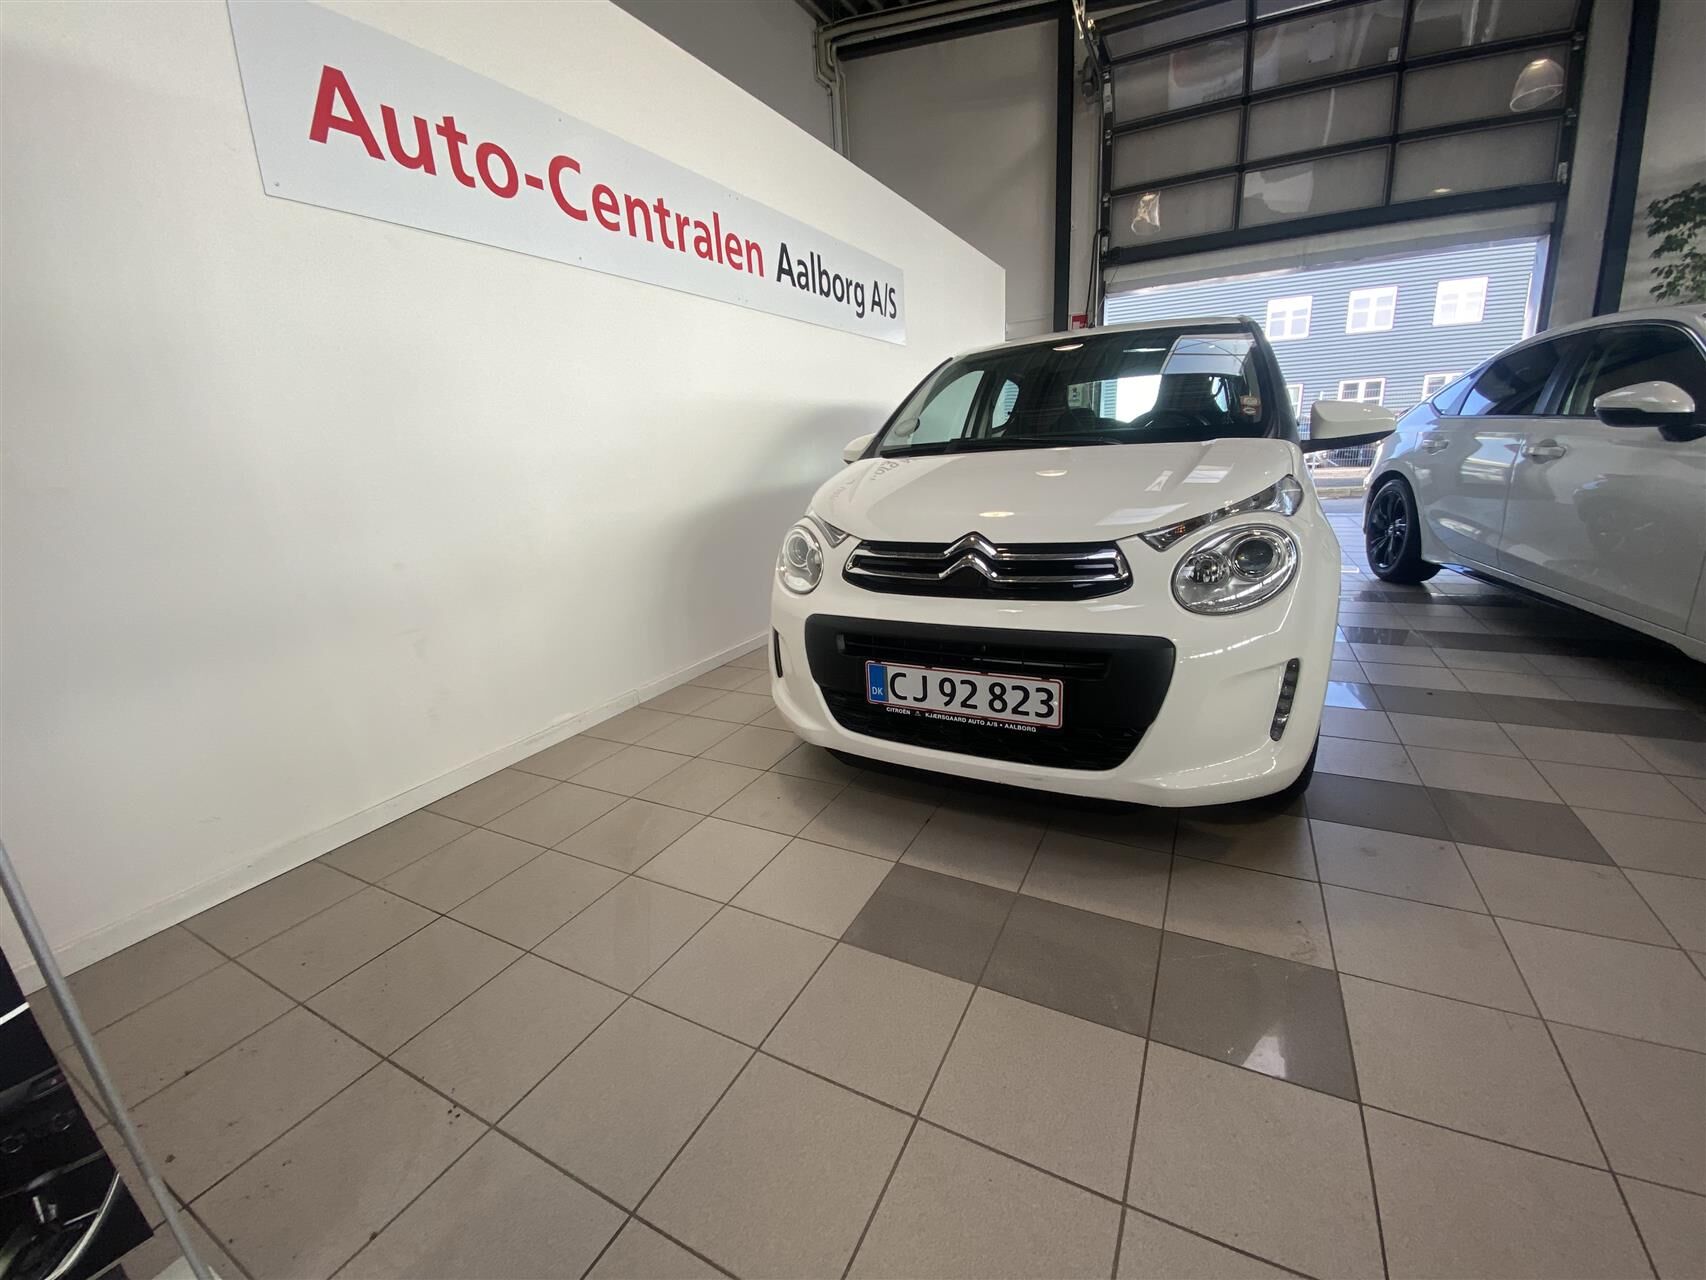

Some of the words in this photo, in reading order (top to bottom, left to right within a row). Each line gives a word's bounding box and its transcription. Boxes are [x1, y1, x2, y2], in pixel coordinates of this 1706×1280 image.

[309, 64, 765, 278] Auto-Centralen
[776, 242, 866, 319] Aalborg
[870, 280, 897, 319] A/S
[872, 686, 883, 696] DK
[889, 672, 928, 702] CJ
[938, 677, 978, 709] 92
[988, 682, 1054, 718] 823
[886, 706, 911, 715] CITROËN
[968, 718, 985, 726] AUTO
[986, 720, 998, 728] A/S
[1004, 723, 1037, 733] AALBORG
